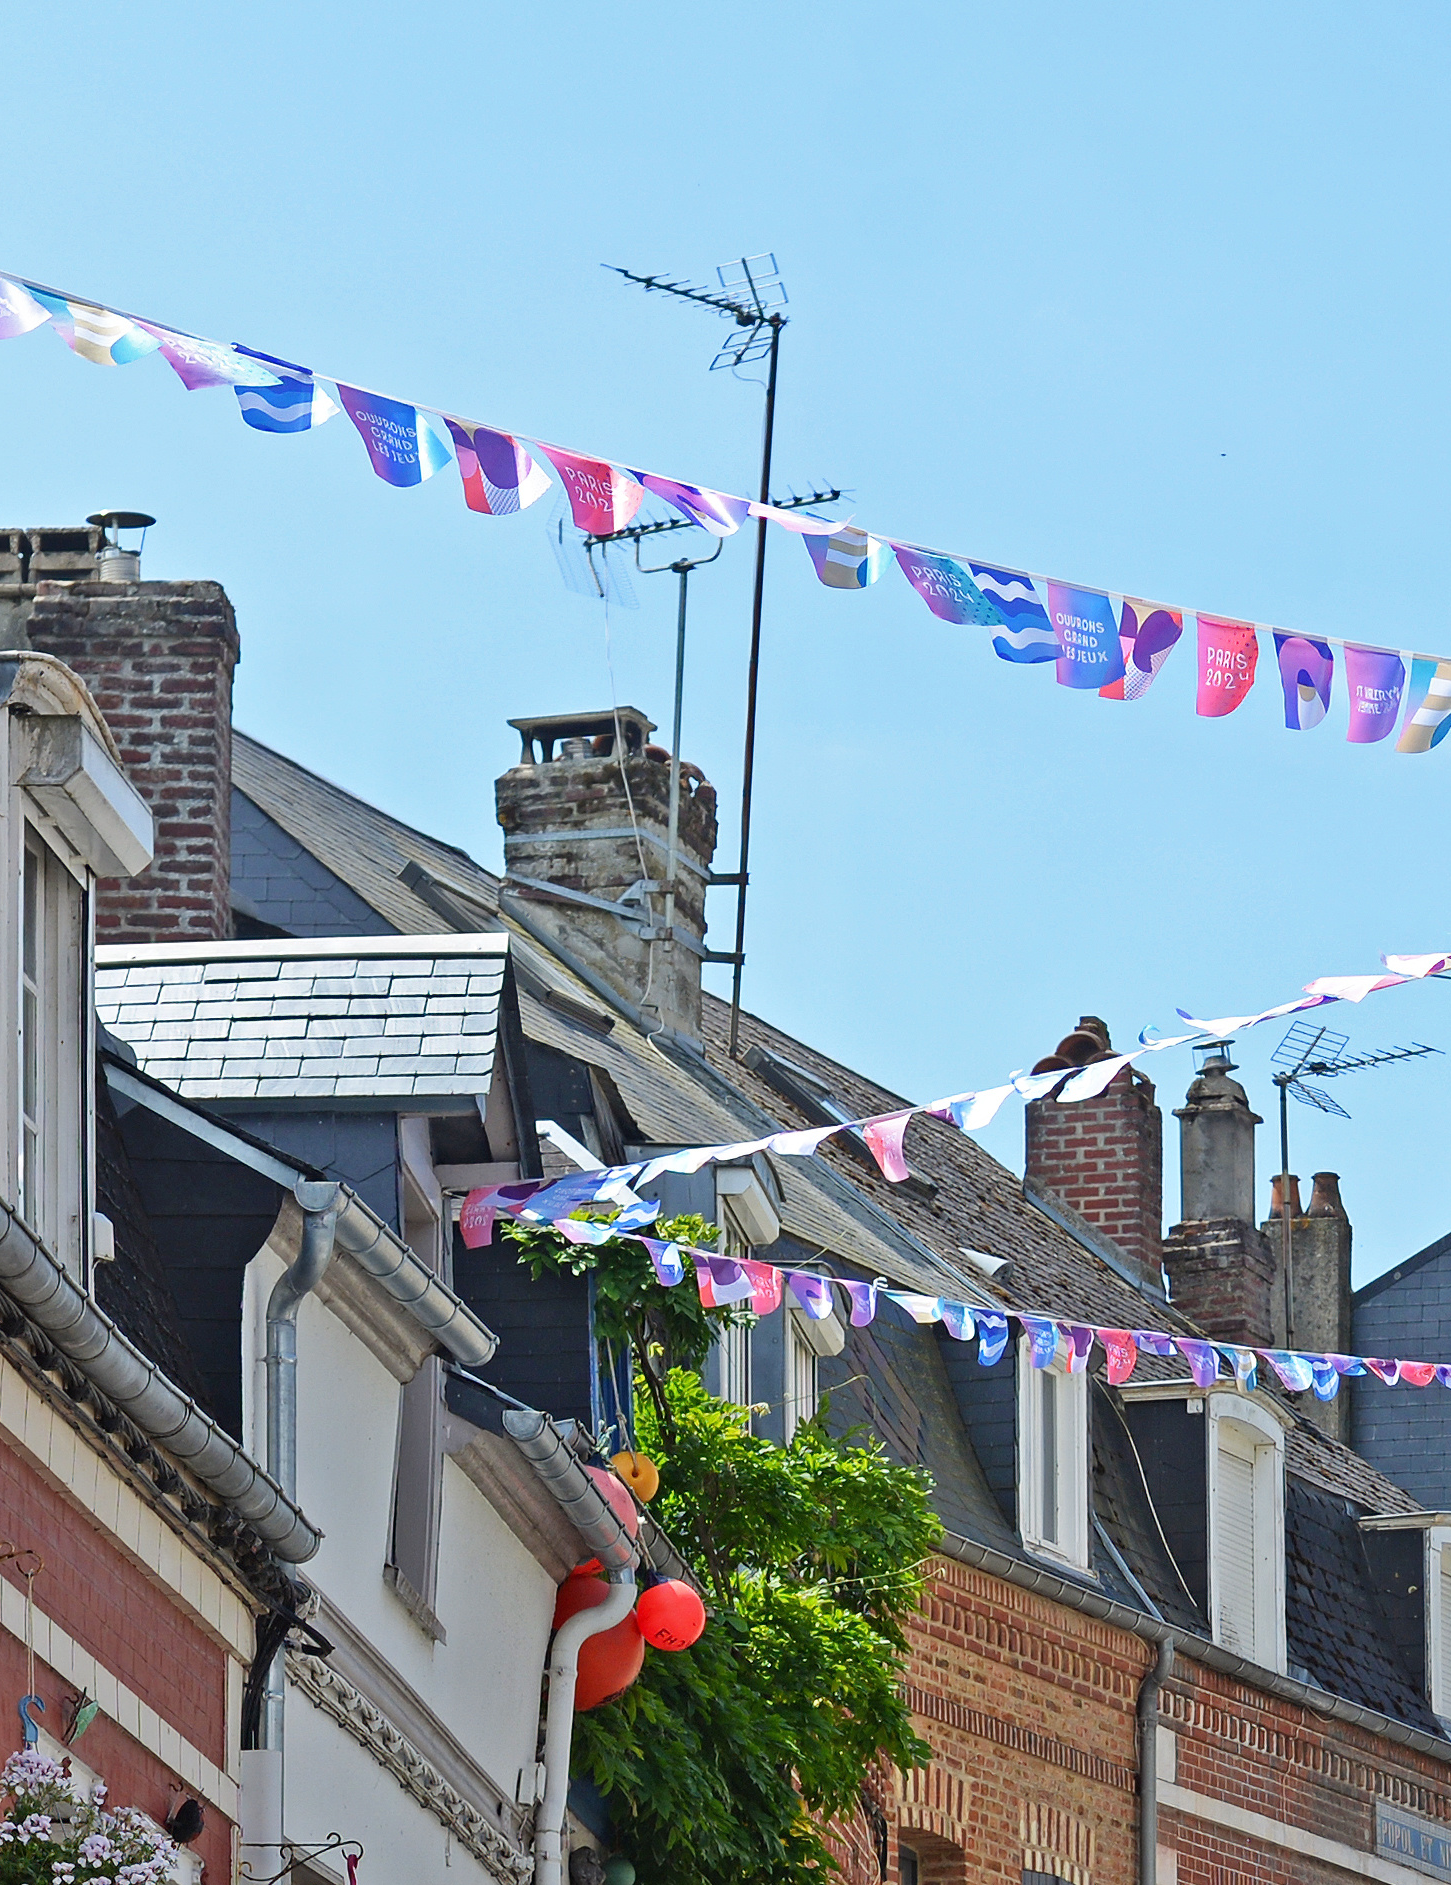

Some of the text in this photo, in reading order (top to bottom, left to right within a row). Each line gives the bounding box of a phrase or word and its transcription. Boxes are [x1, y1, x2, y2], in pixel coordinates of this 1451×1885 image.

[574, 485, 613, 512] 202
[910, 564, 961, 587] PARIS
[922, 581, 974, 604] 2024
[1063, 629, 1098, 648] GRAND
[1077, 649, 1108, 664] JEUX
[1207, 646, 1247, 670] PARIS
[1381, 1818, 1415, 1856] POPOL
[1420, 1833, 1433, 1862] ET
